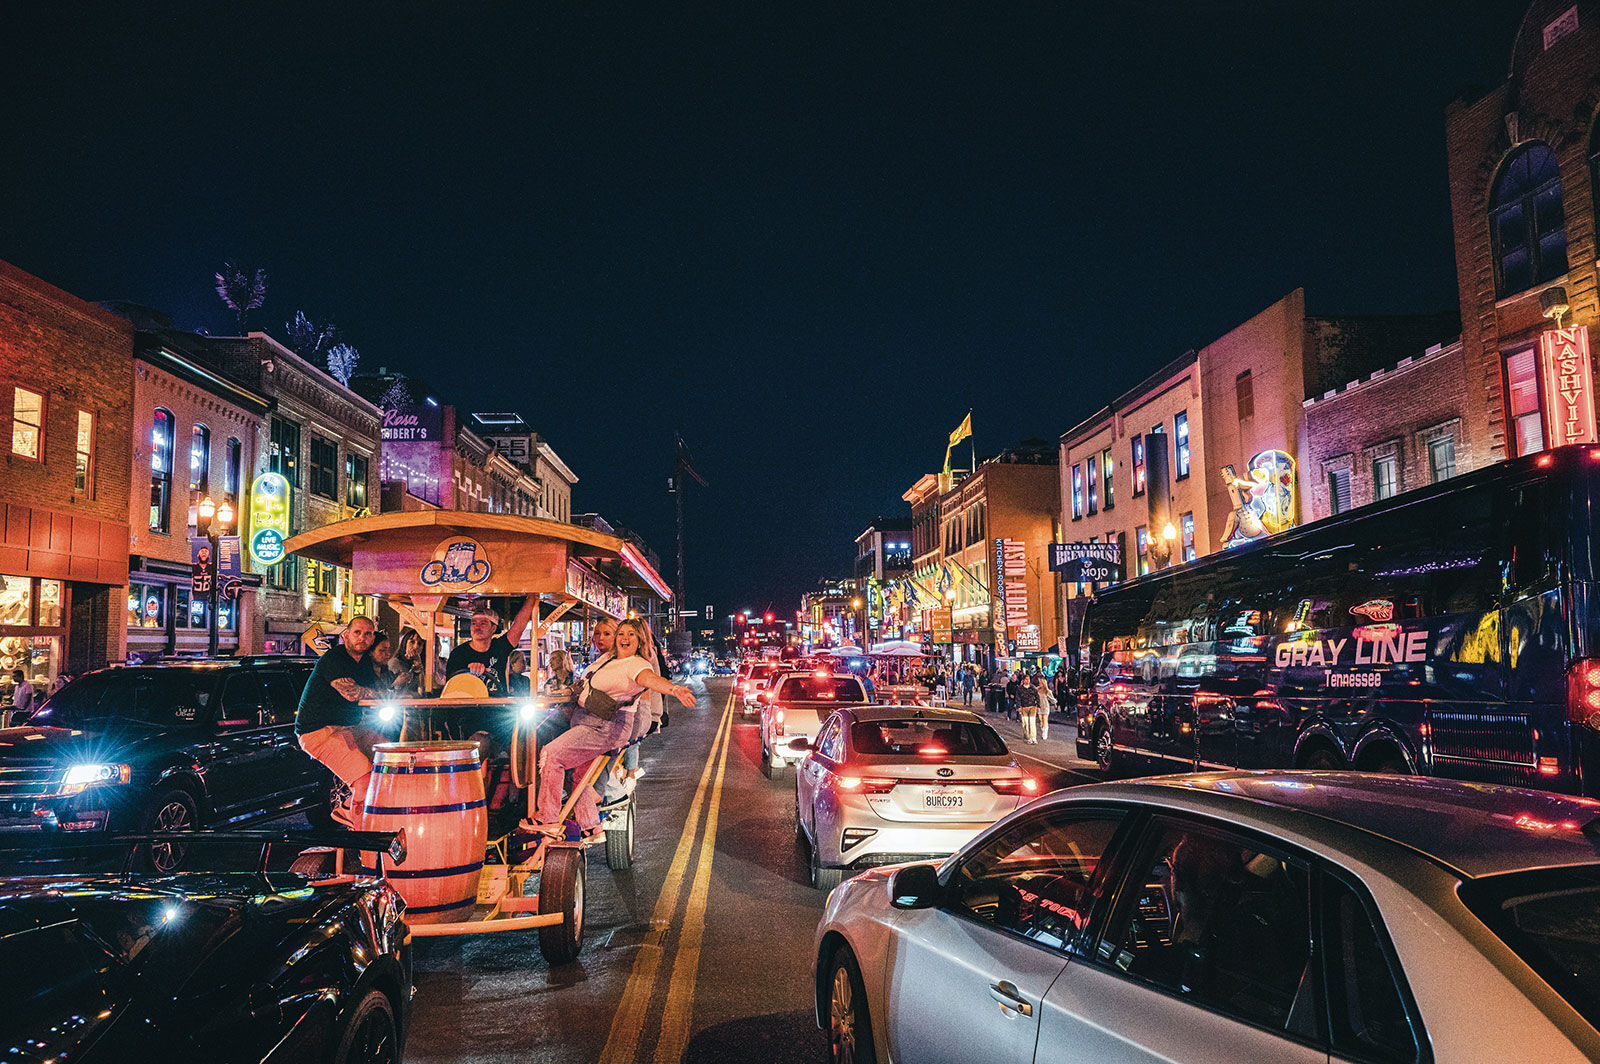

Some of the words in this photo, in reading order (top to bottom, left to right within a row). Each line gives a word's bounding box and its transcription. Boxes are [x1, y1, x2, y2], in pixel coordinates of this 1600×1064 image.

[383, 409, 419, 427] Rosa
[256, 543, 281, 551] MUSIC
[996, 538, 1004, 570] KITCHEN
[1004, 538, 1027, 577] JASON
[1056, 550, 1121, 566] BREWHOUSE
[1080, 568, 1108, 581] MOJO
[1005, 581, 1029, 627] ALDEAN
[1275, 638, 1347, 668] GRAY
[1355, 630, 1429, 665] LINE
[1324, 669, 1382, 688] Tennessee
[926, 796, 963, 806] 8URC993
